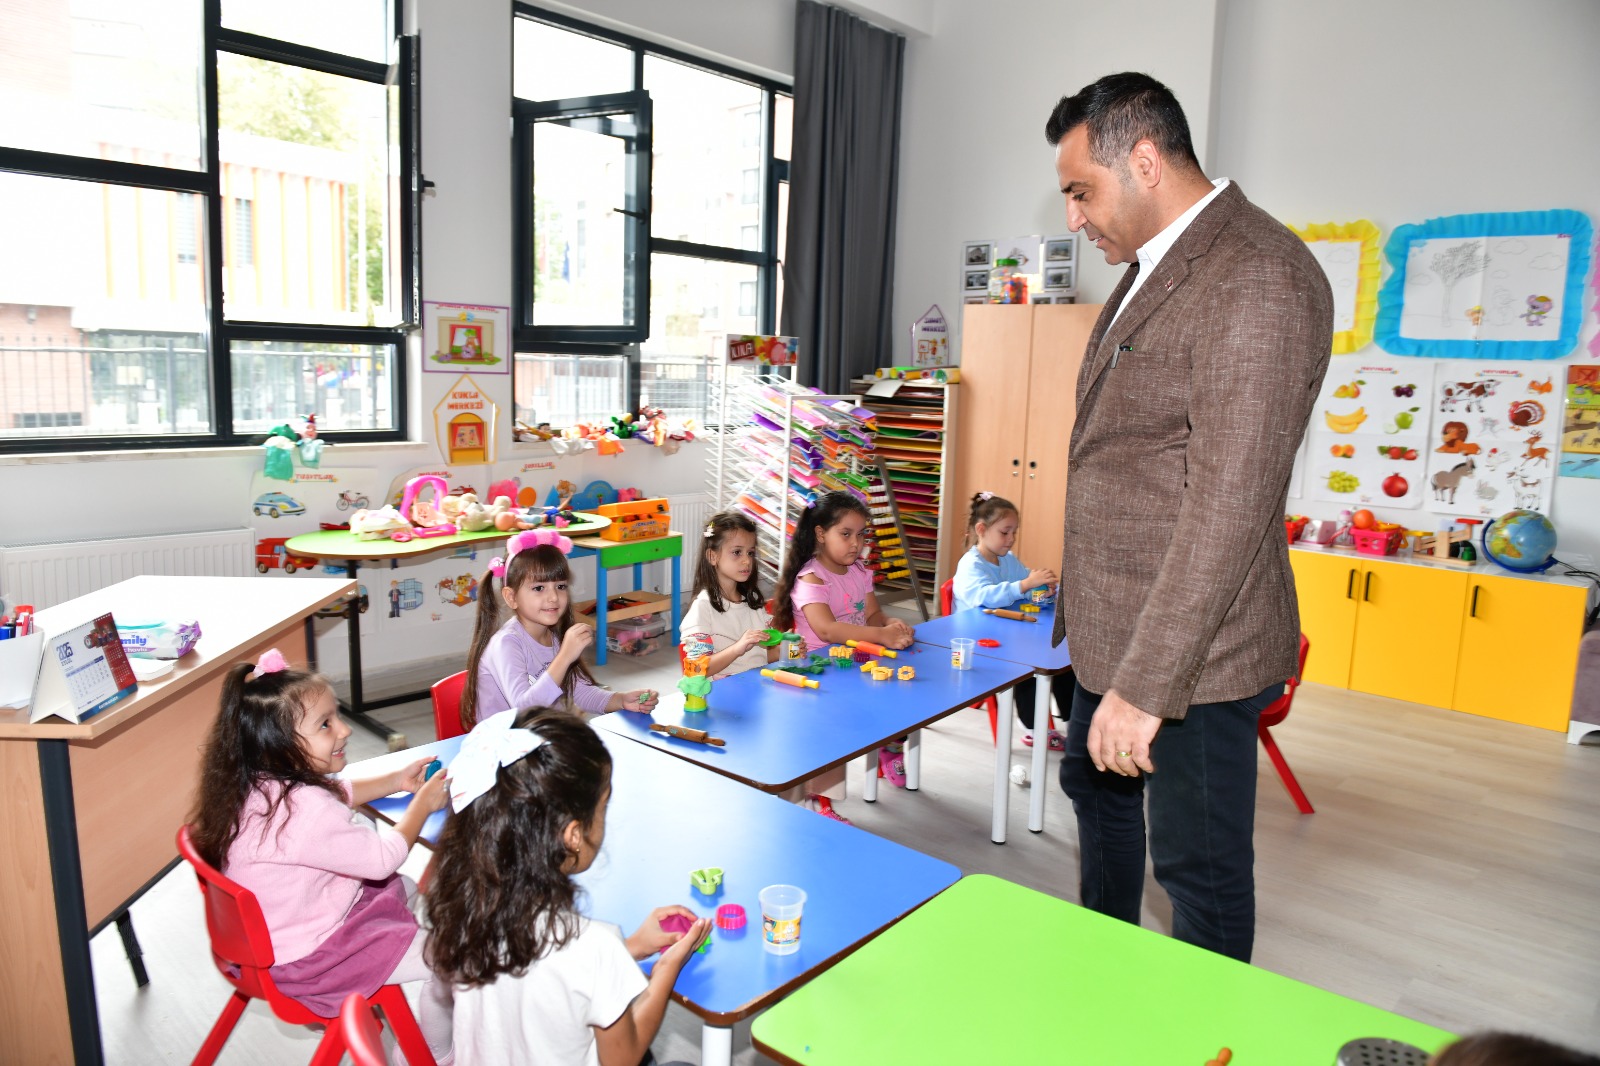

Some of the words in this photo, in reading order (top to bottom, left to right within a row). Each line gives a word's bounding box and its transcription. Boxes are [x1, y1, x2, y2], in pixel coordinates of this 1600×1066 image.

[451, 391, 478, 399] KUKLA
[120, 635, 147, 646] mily
[56, 642, 74, 661] 2025
